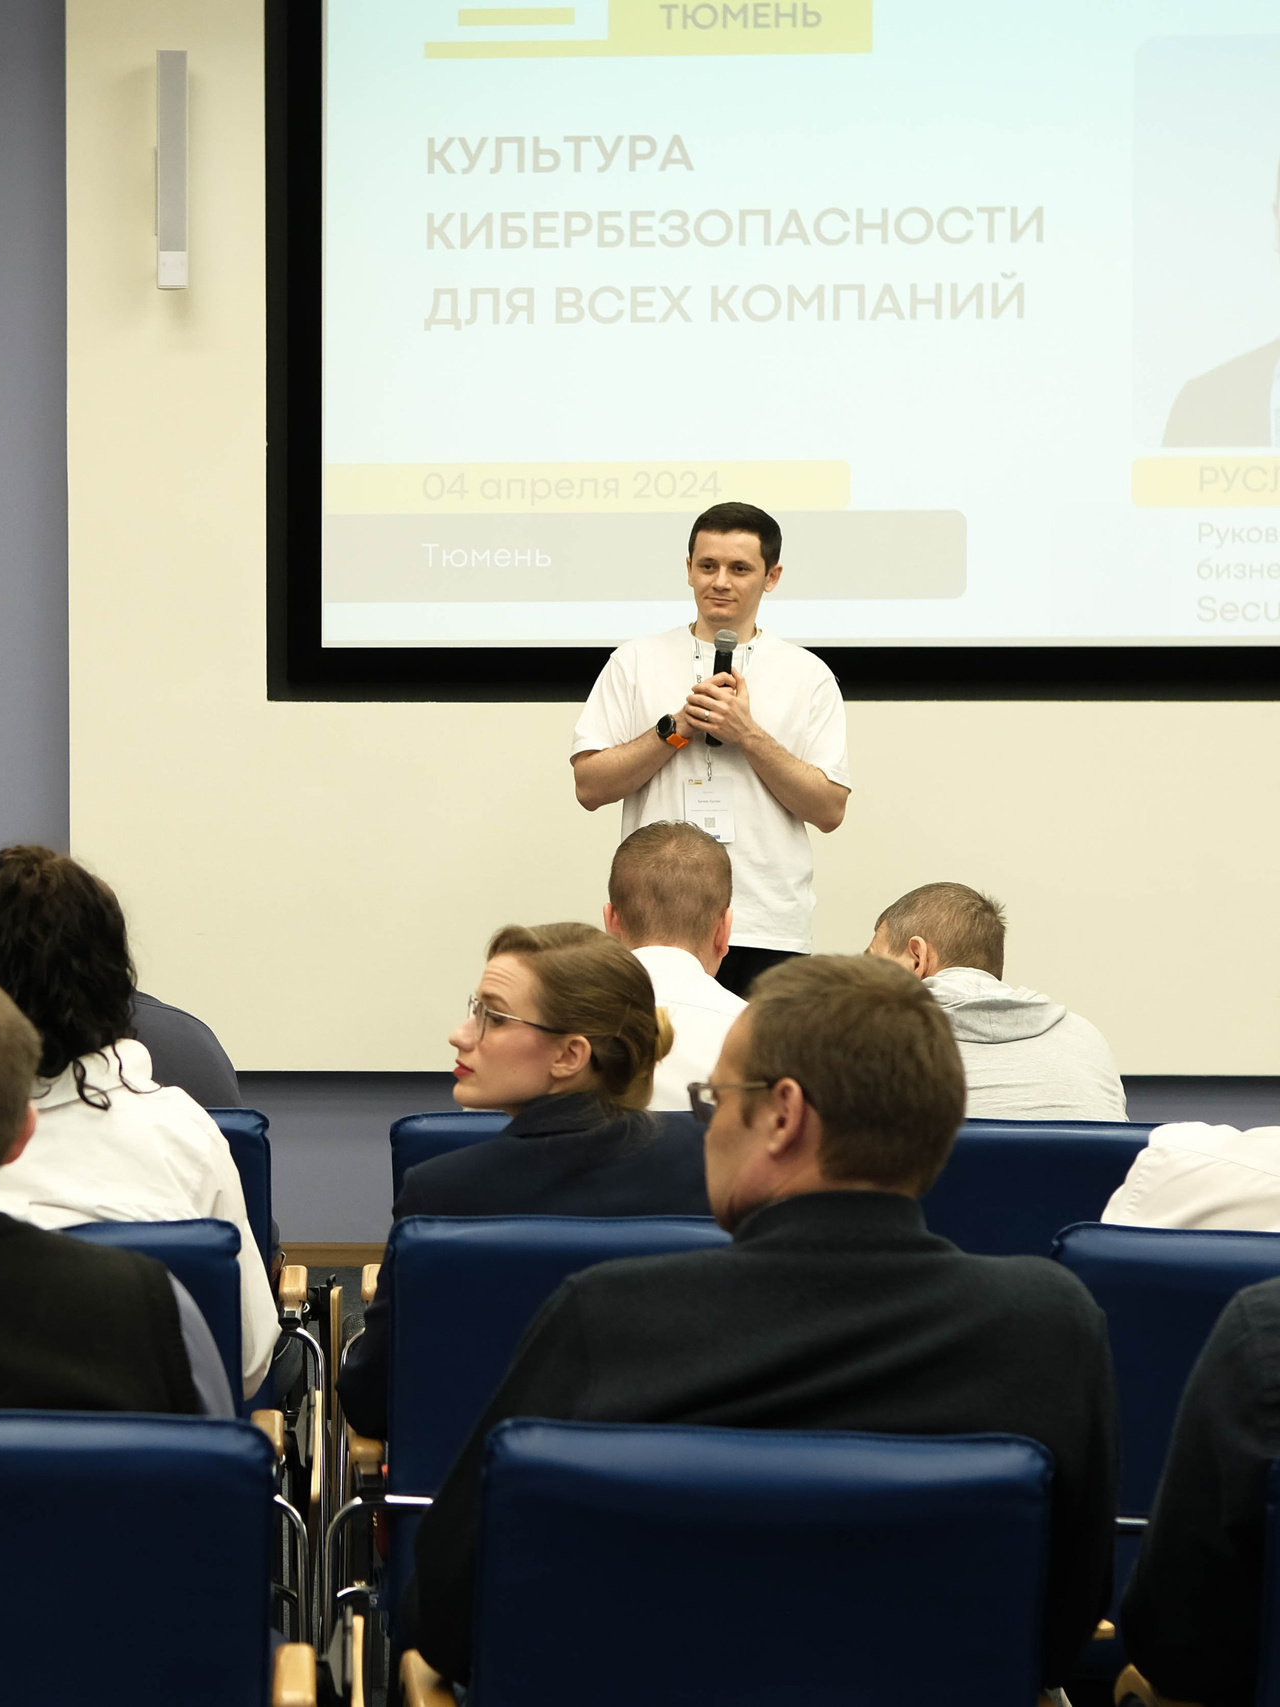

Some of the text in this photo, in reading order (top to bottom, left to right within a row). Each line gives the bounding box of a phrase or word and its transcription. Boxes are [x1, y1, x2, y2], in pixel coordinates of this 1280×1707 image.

[659, 2, 823, 30] ТЮМЕНЬ
[426, 134, 695, 175] КУЛЬТУРА
[426, 205, 1045, 250] КИБЕРБЕЗОПАСНОСТИ
[423, 270, 1026, 331] ДЛЯ ВСЕХ КОМПАНИЙ
[422, 470, 723, 506] 04 апреля 2024
[421, 543, 553, 568] Тюмень
